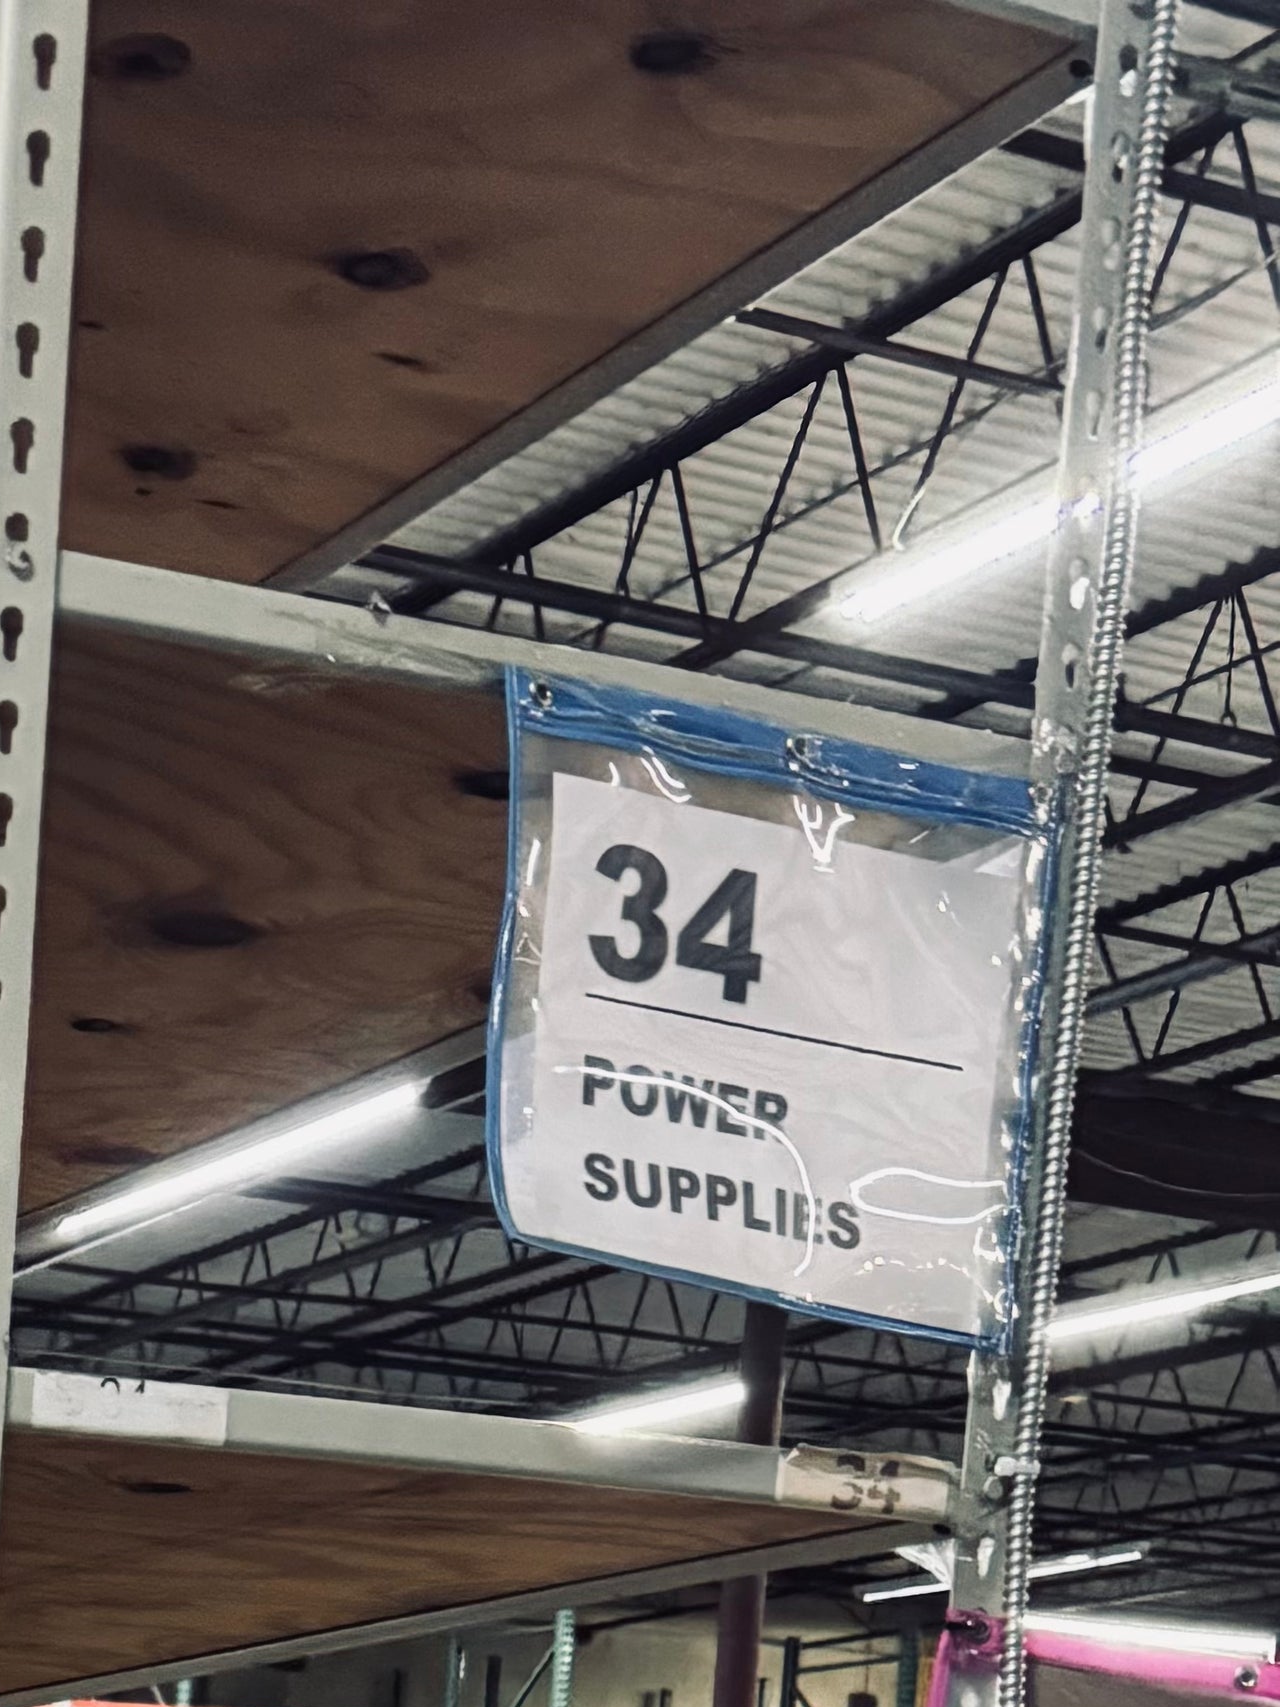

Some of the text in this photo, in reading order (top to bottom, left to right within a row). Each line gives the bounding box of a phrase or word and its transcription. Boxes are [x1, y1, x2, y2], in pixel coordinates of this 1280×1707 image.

[587, 843, 764, 1006] 34
[582, 1053, 789, 1141] POWER
[583, 1152, 862, 1251] SUPPLIES
